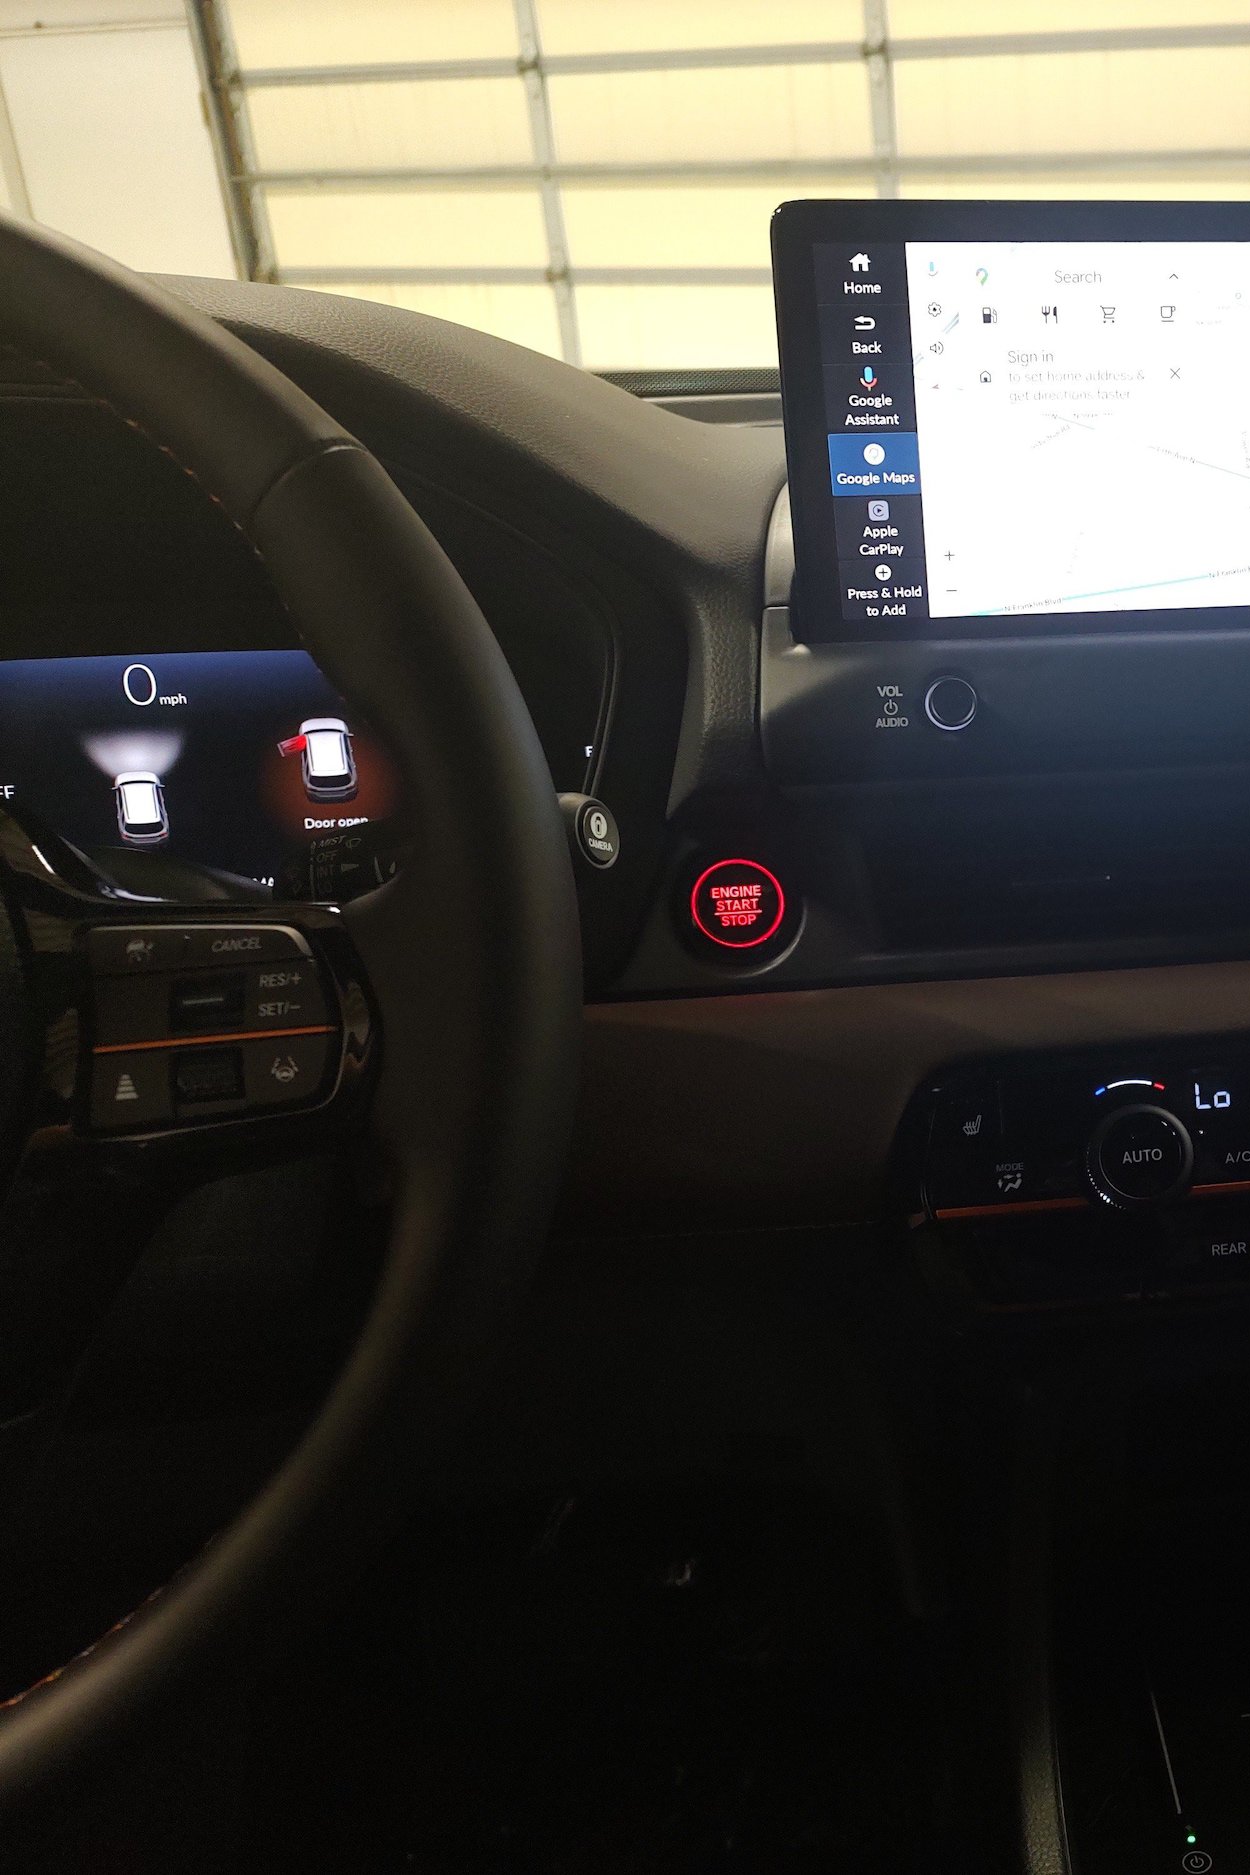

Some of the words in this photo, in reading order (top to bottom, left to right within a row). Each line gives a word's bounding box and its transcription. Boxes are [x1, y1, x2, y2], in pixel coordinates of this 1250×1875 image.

[1054, 270, 1102, 284] Search
[844, 281, 881, 294] Home
[852, 341, 882, 354] Back
[1008, 350, 1037, 367] Sign
[1042, 350, 1054, 363] in
[1009, 372, 1020, 383] to
[1025, 372, 1042, 382] set
[1047, 371, 1081, 382] home
[1086, 370, 1133, 381] address
[848, 395, 892, 408] Google
[845, 413, 899, 426] Assistant
[837, 472, 880, 486] Google
[883, 471, 915, 485] Maps
[863, 525, 898, 539] Apple
[859, 543, 904, 557] CarPlay
[847, 588, 878, 600] Press
[881, 587, 892, 599] &
[895, 585, 922, 598] Hold
[866, 606, 879, 617] to
[881, 604, 906, 616] Add
[122, 663, 157, 706] 0
[159, 692, 187, 706] mph
[877, 686, 903, 697] VOL
[876, 717, 909, 728] AUDIO
[584, 745, 593, 758] F
[304, 817, 336, 829] Door
[588, 838, 613, 852] CAMERA
[711, 884, 762, 899] ENGINE
[716, 898, 759, 912] START
[721, 914, 757, 927] STOP
[211, 937, 262, 952] CANCEL
[1122, 1148, 1163, 1164] AUTO
[995, 1162, 1024, 1172] MODE
[1211, 1242, 1247, 1256] REAR
